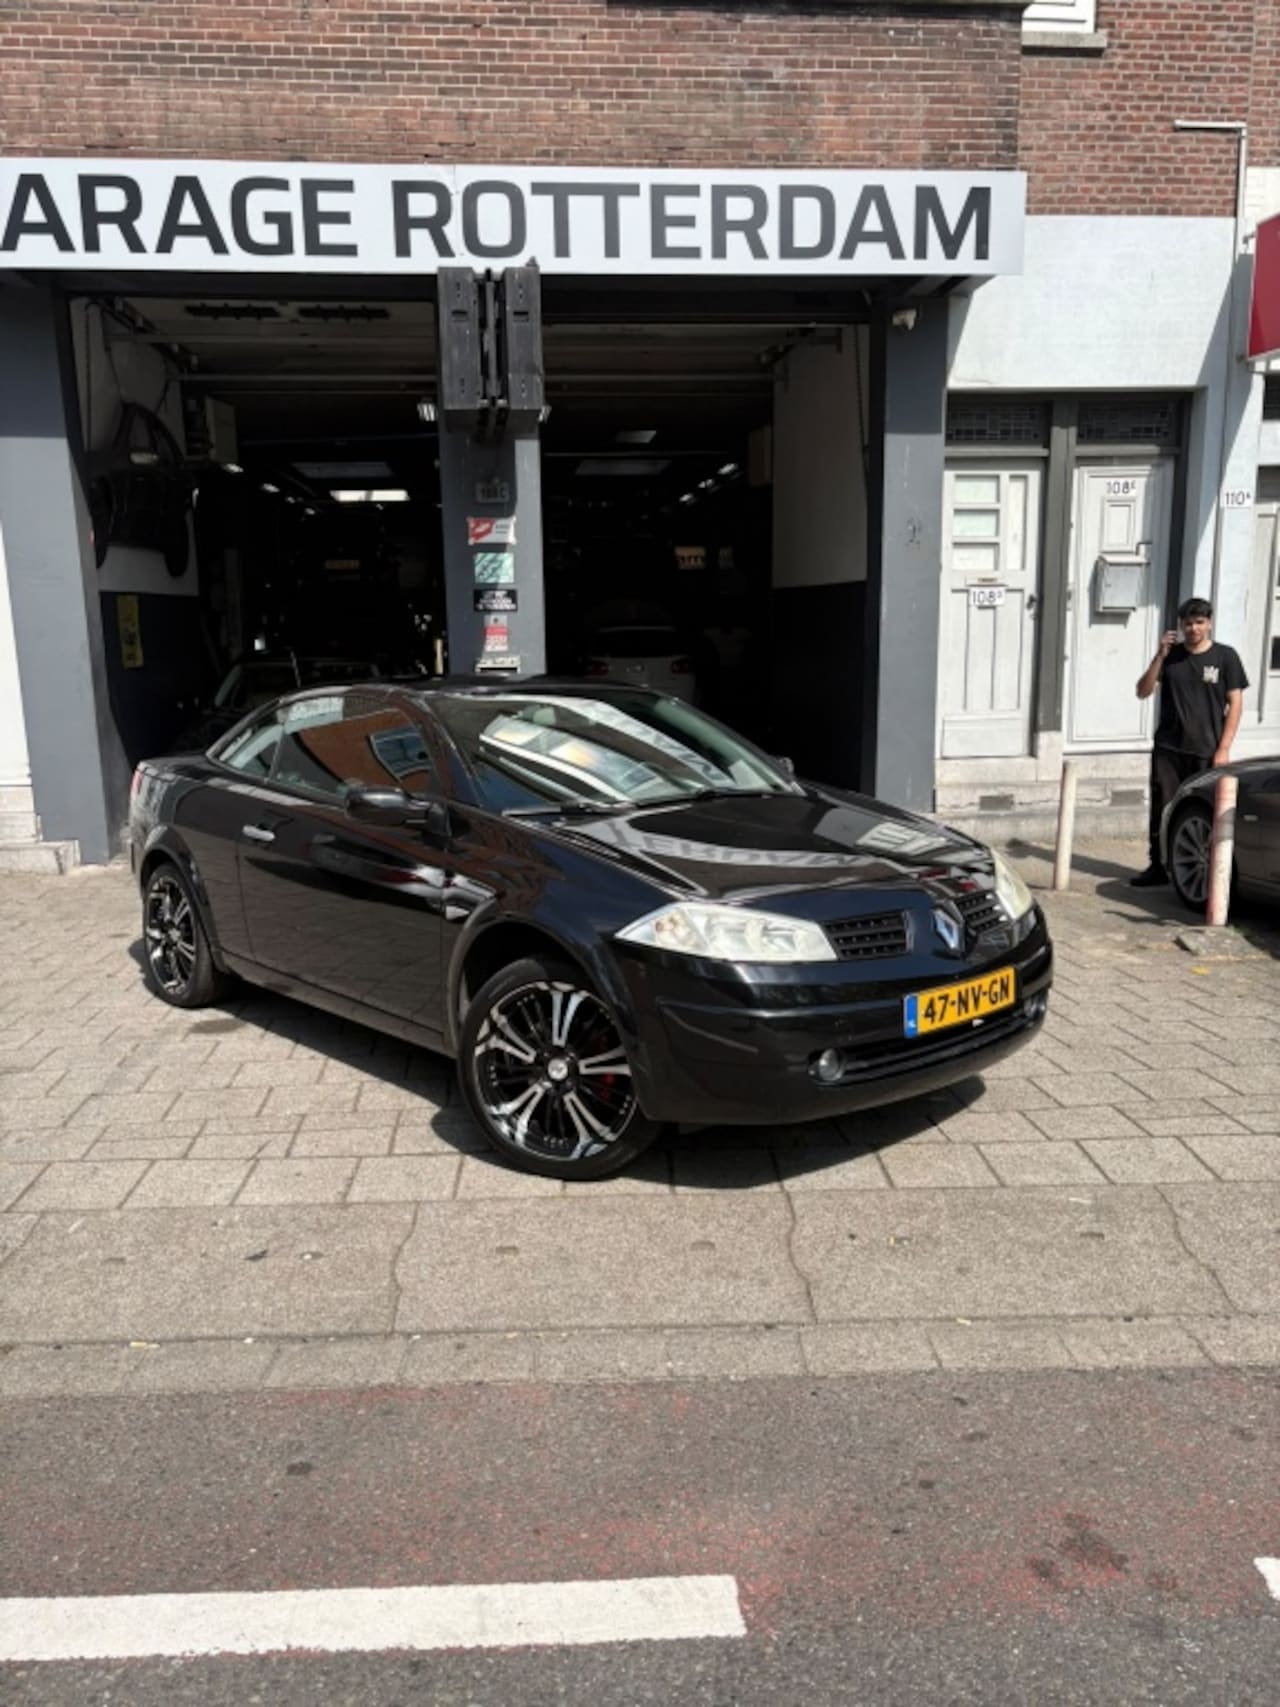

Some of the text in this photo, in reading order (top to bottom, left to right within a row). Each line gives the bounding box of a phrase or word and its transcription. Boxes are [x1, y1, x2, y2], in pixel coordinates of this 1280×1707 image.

[0, 173, 992, 260] ARAGE ROTTERDAM
[924, 974, 1010, 1024] 47-NV-GN
